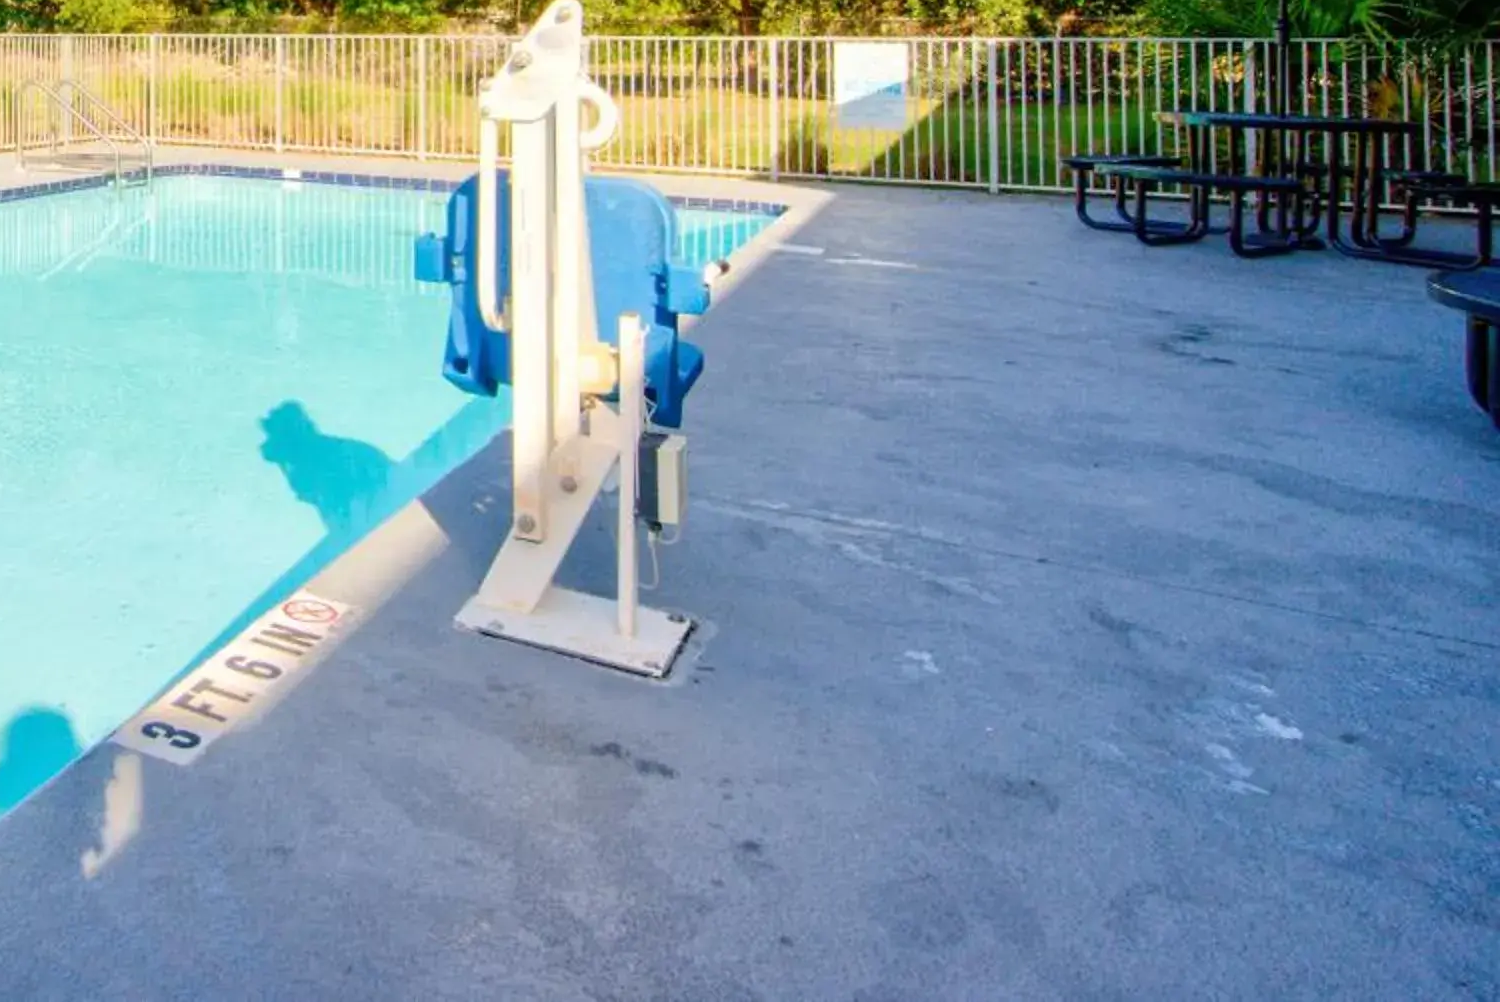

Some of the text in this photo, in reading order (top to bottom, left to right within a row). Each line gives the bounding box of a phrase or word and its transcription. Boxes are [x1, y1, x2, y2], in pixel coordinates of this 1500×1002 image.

[250, 623, 322, 656] IN
[225, 655, 282, 681] 6
[141, 721, 201, 749] 3
